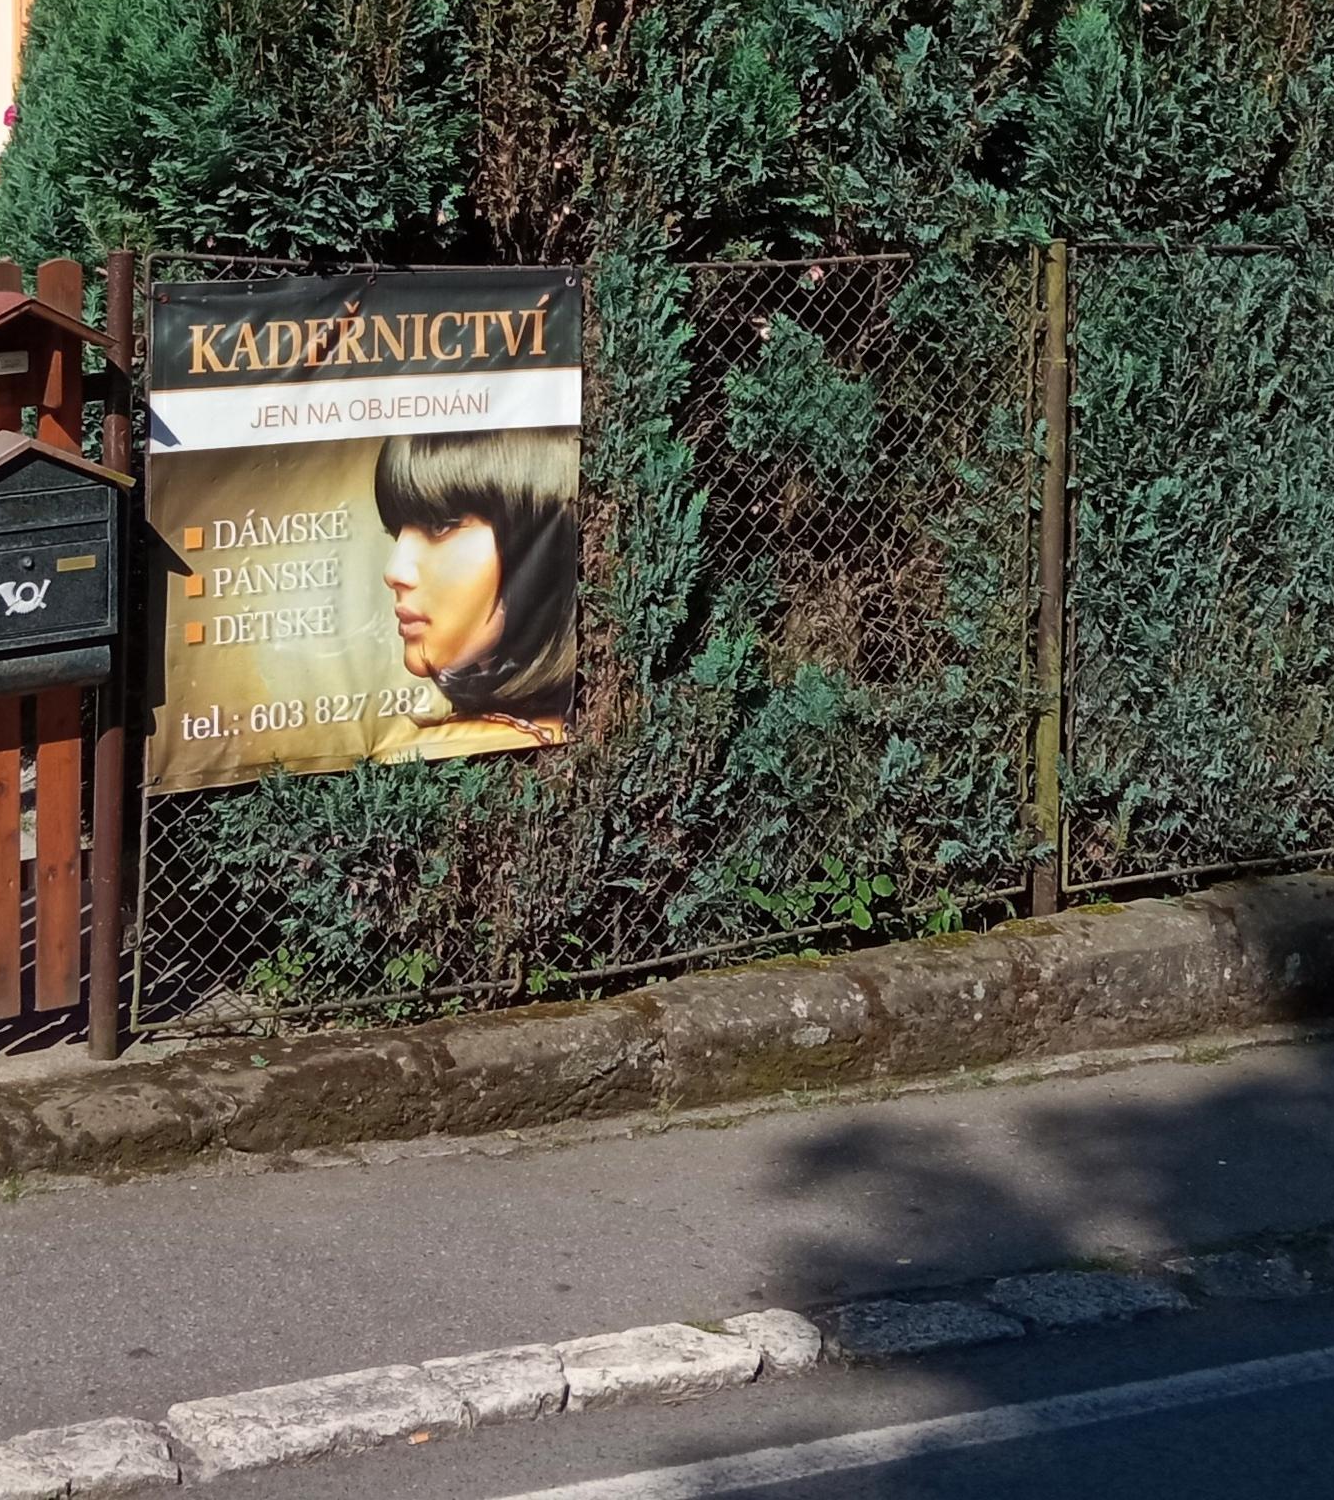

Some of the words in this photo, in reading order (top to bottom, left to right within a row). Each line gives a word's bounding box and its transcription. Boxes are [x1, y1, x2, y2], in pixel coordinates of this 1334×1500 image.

[188, 293, 551, 375] KADEŘNICTVÍ
[250, 404, 298, 430] JEN
[307, 401, 342, 425] NA
[348, 387, 490, 422] OBJEDNÁNÍ
[212, 502, 349, 550] DÁMSKÉ
[212, 550, 340, 598] PÁNSKÉ
[212, 598, 335, 645] DĚTSKÉ
[251, 701, 305, 733] 603
[315, 694, 367, 725] 827
[377, 686, 431, 718] 282
